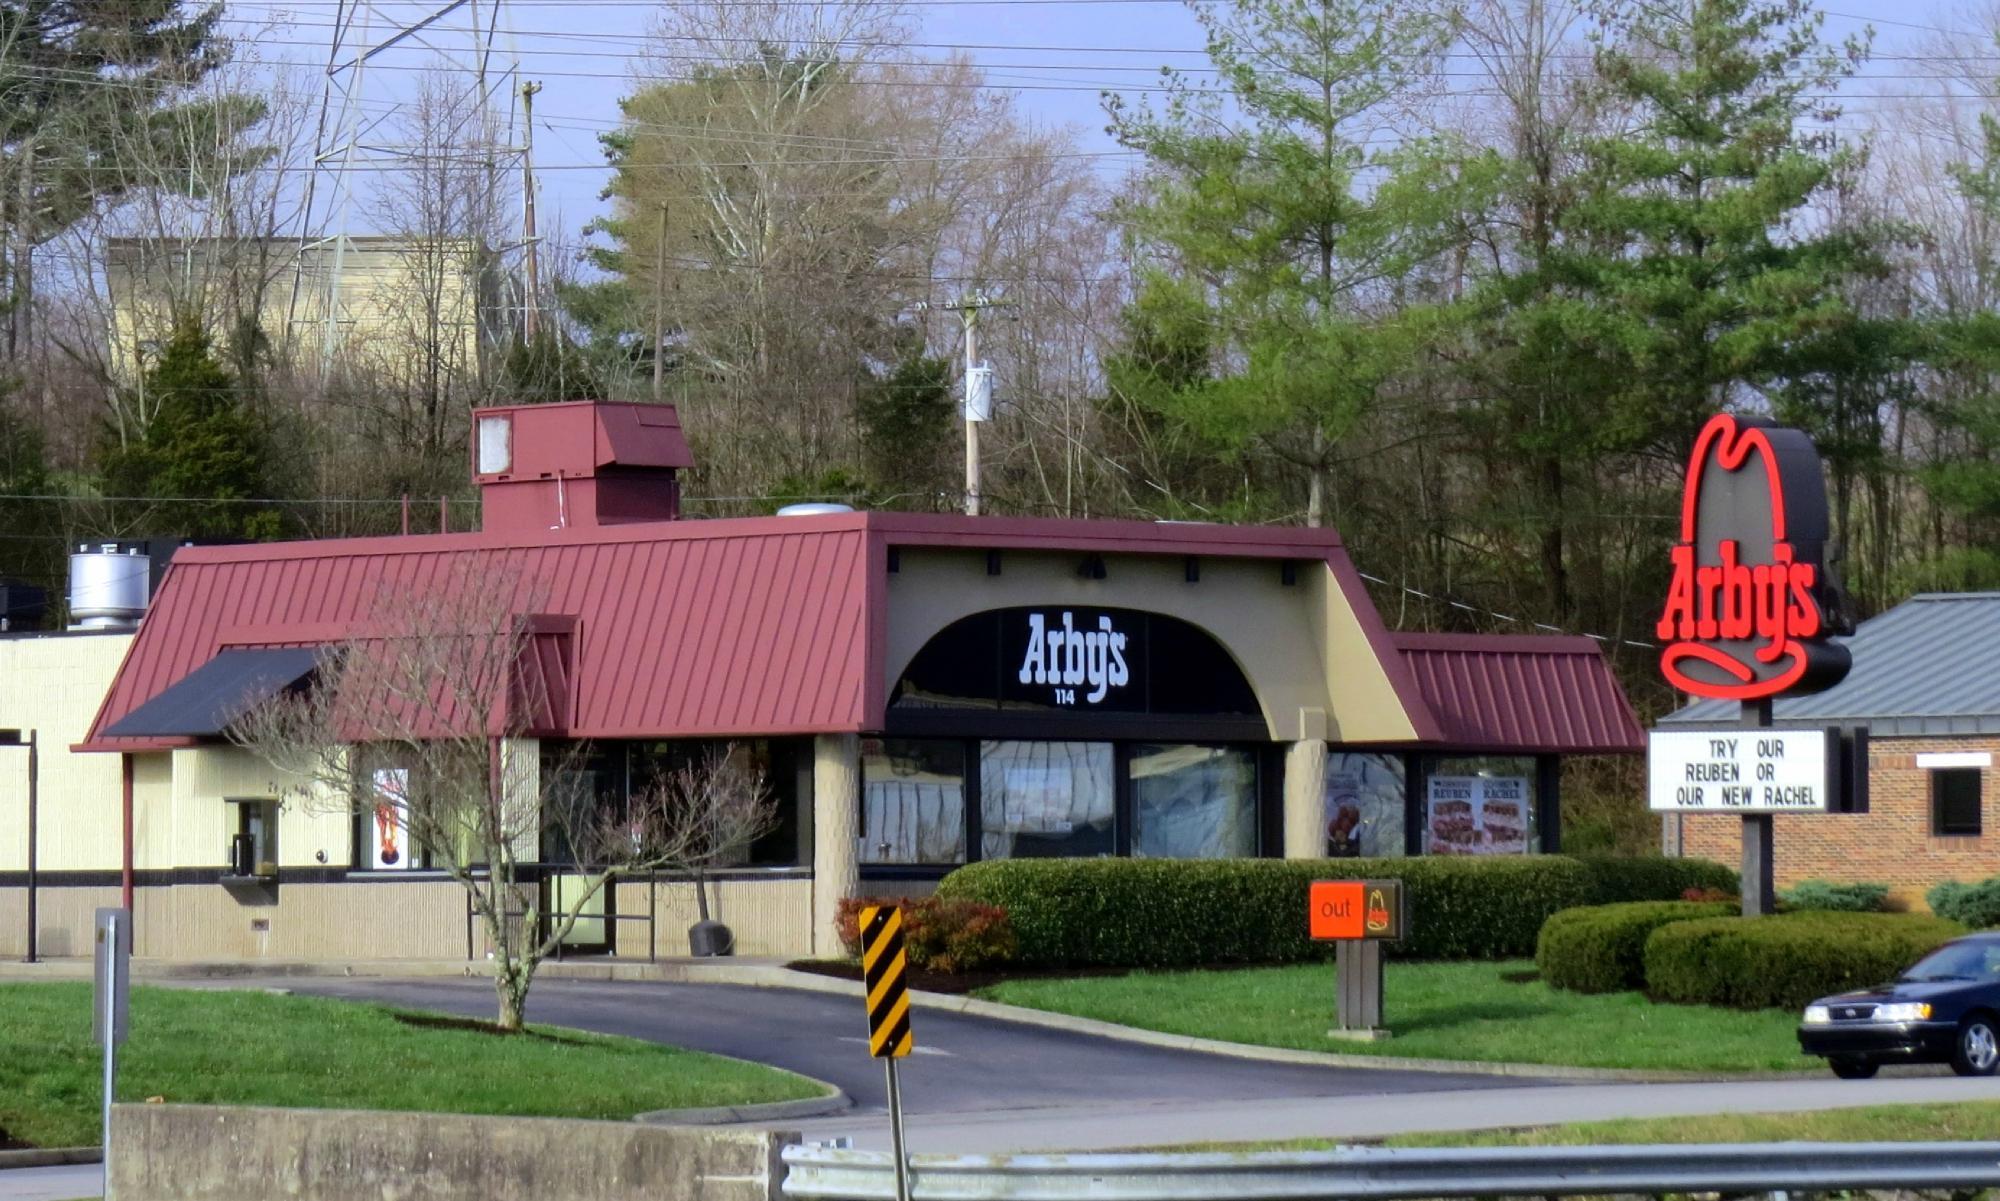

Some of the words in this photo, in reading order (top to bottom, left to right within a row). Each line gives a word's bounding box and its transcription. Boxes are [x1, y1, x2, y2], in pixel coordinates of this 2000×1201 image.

[1657, 540, 1820, 662] Arby's
[1019, 611, 1128, 703] Arby's
[1055, 688, 1075, 704] 114
[1709, 739, 1738, 758] TRY
[1757, 739, 1784, 758] OUR
[1685, 763, 1739, 782] REUBEN
[1757, 763, 1775, 781] OR
[1433, 788, 1472, 799] REUBEN
[1676, 787, 1704, 806] OUR
[1722, 787, 1752, 806] NEW
[1764, 787, 1816, 806] RACHEL
[1321, 899, 1351, 918] out
